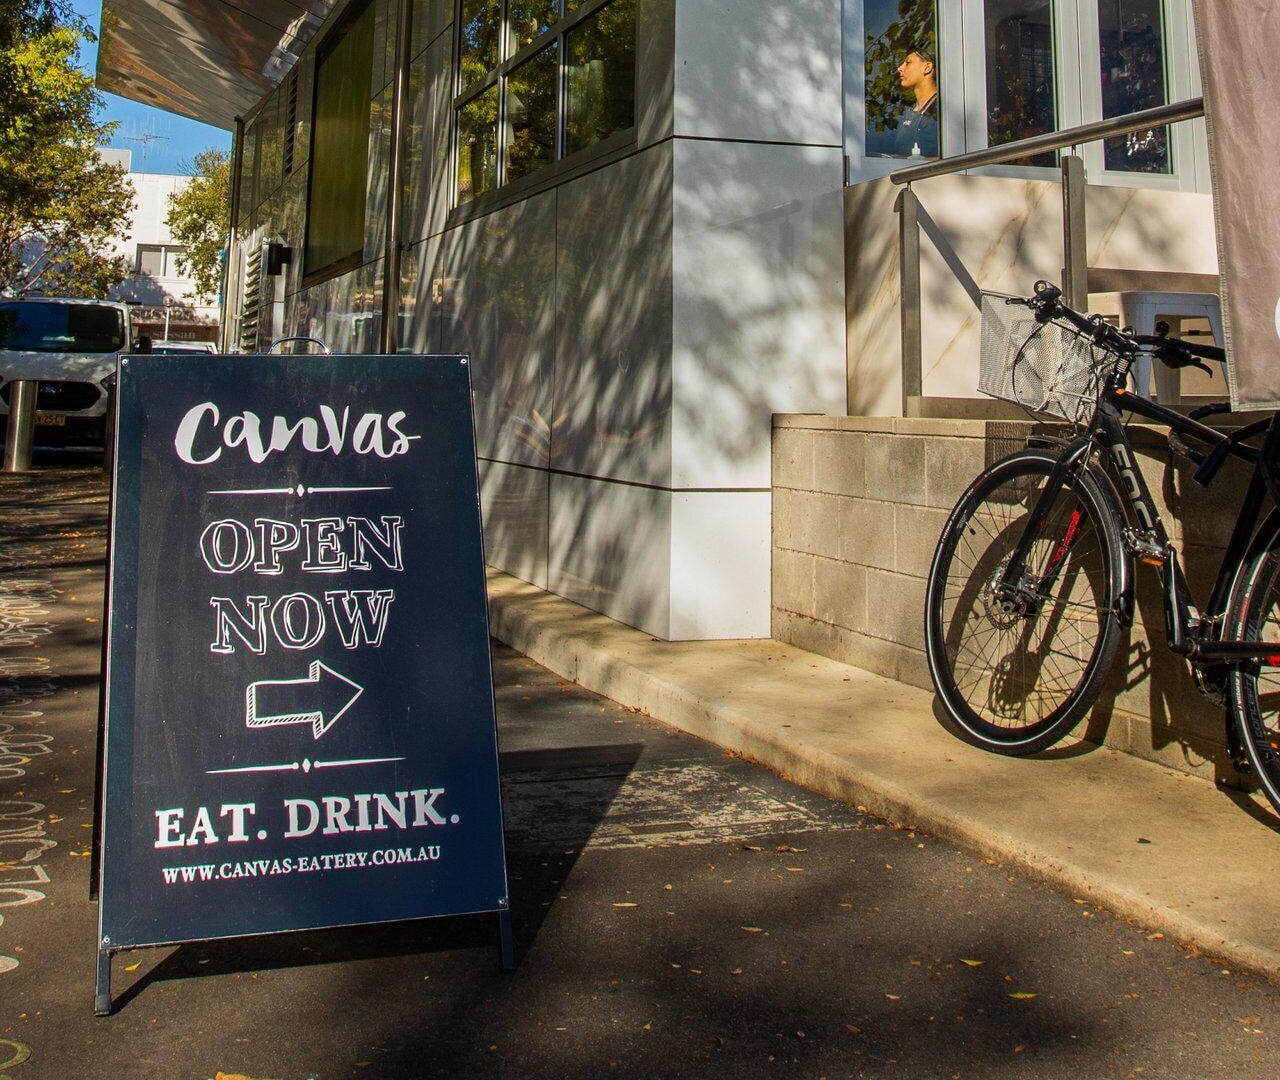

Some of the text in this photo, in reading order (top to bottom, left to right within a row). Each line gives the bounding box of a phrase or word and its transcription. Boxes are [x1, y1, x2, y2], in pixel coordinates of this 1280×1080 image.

[174, 400, 421, 466] Canvas
[199, 515, 405, 576] OPEN
[209, 588, 395, 655] NOW
[153, 786, 461, 849] EAT. DRINK.
[161, 844, 442, 886] WWW.CANVAS-EATERY.COM.AU
